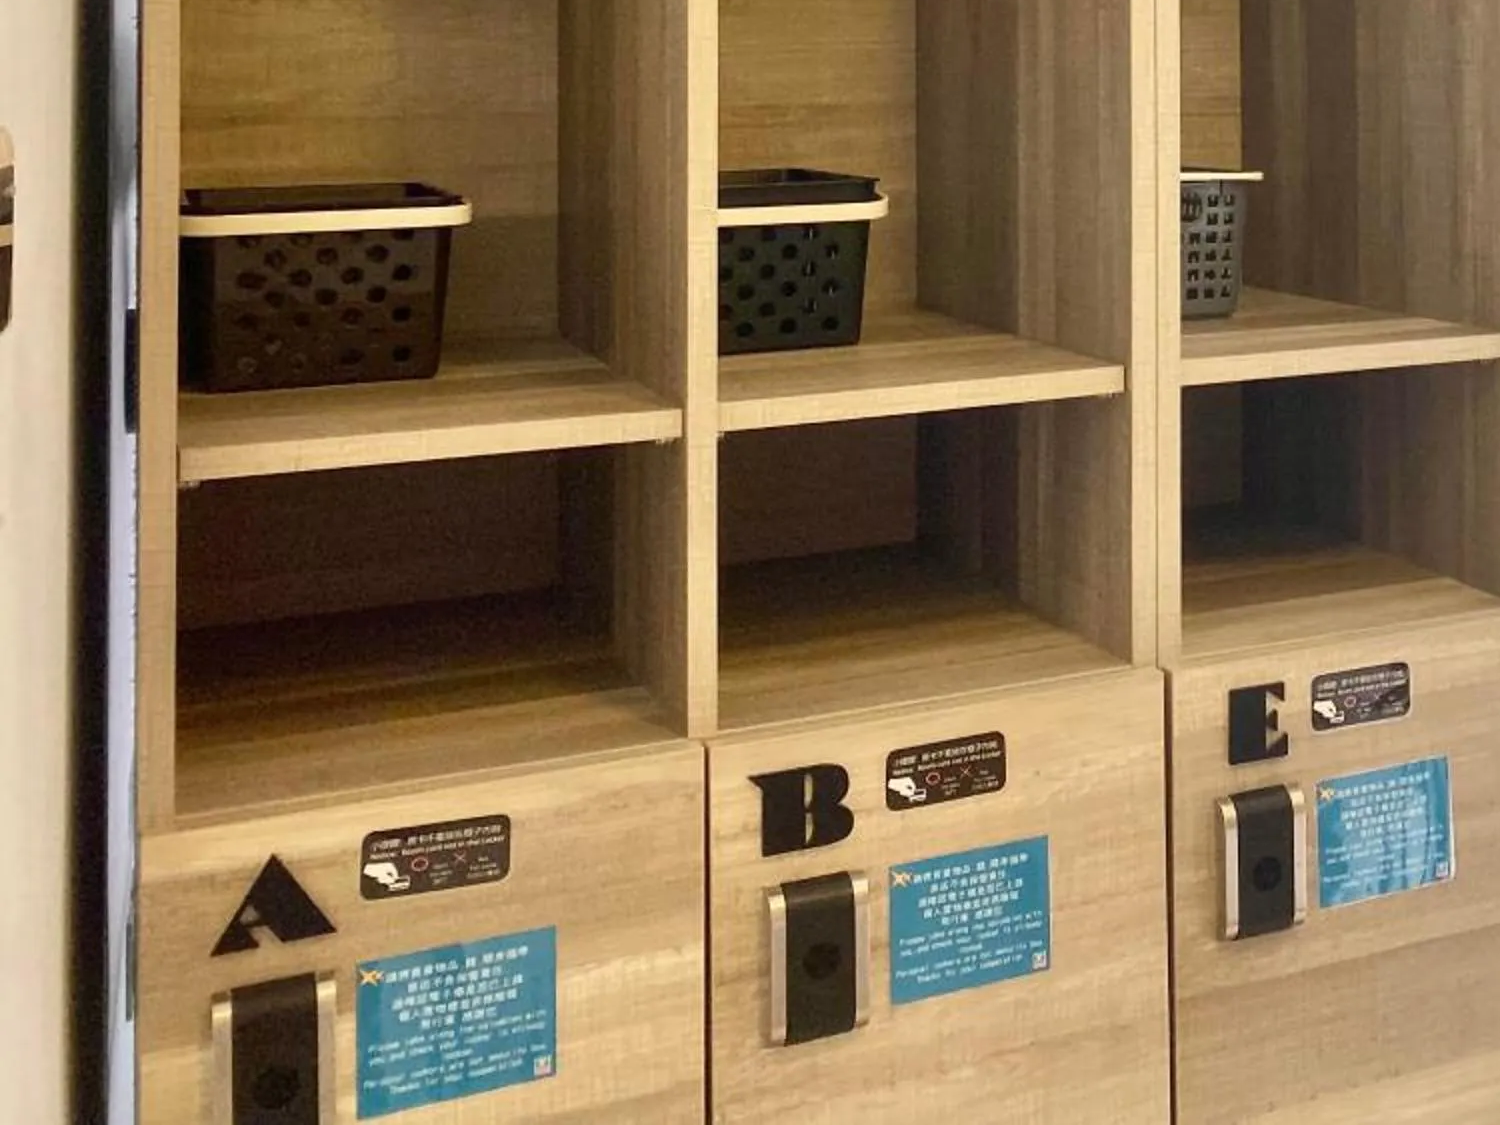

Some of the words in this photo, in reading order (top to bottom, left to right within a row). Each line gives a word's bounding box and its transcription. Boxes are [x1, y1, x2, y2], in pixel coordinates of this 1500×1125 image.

[1228, 681, 1289, 765] E
[747, 763, 854, 857] B
[210, 853, 336, 957] A
